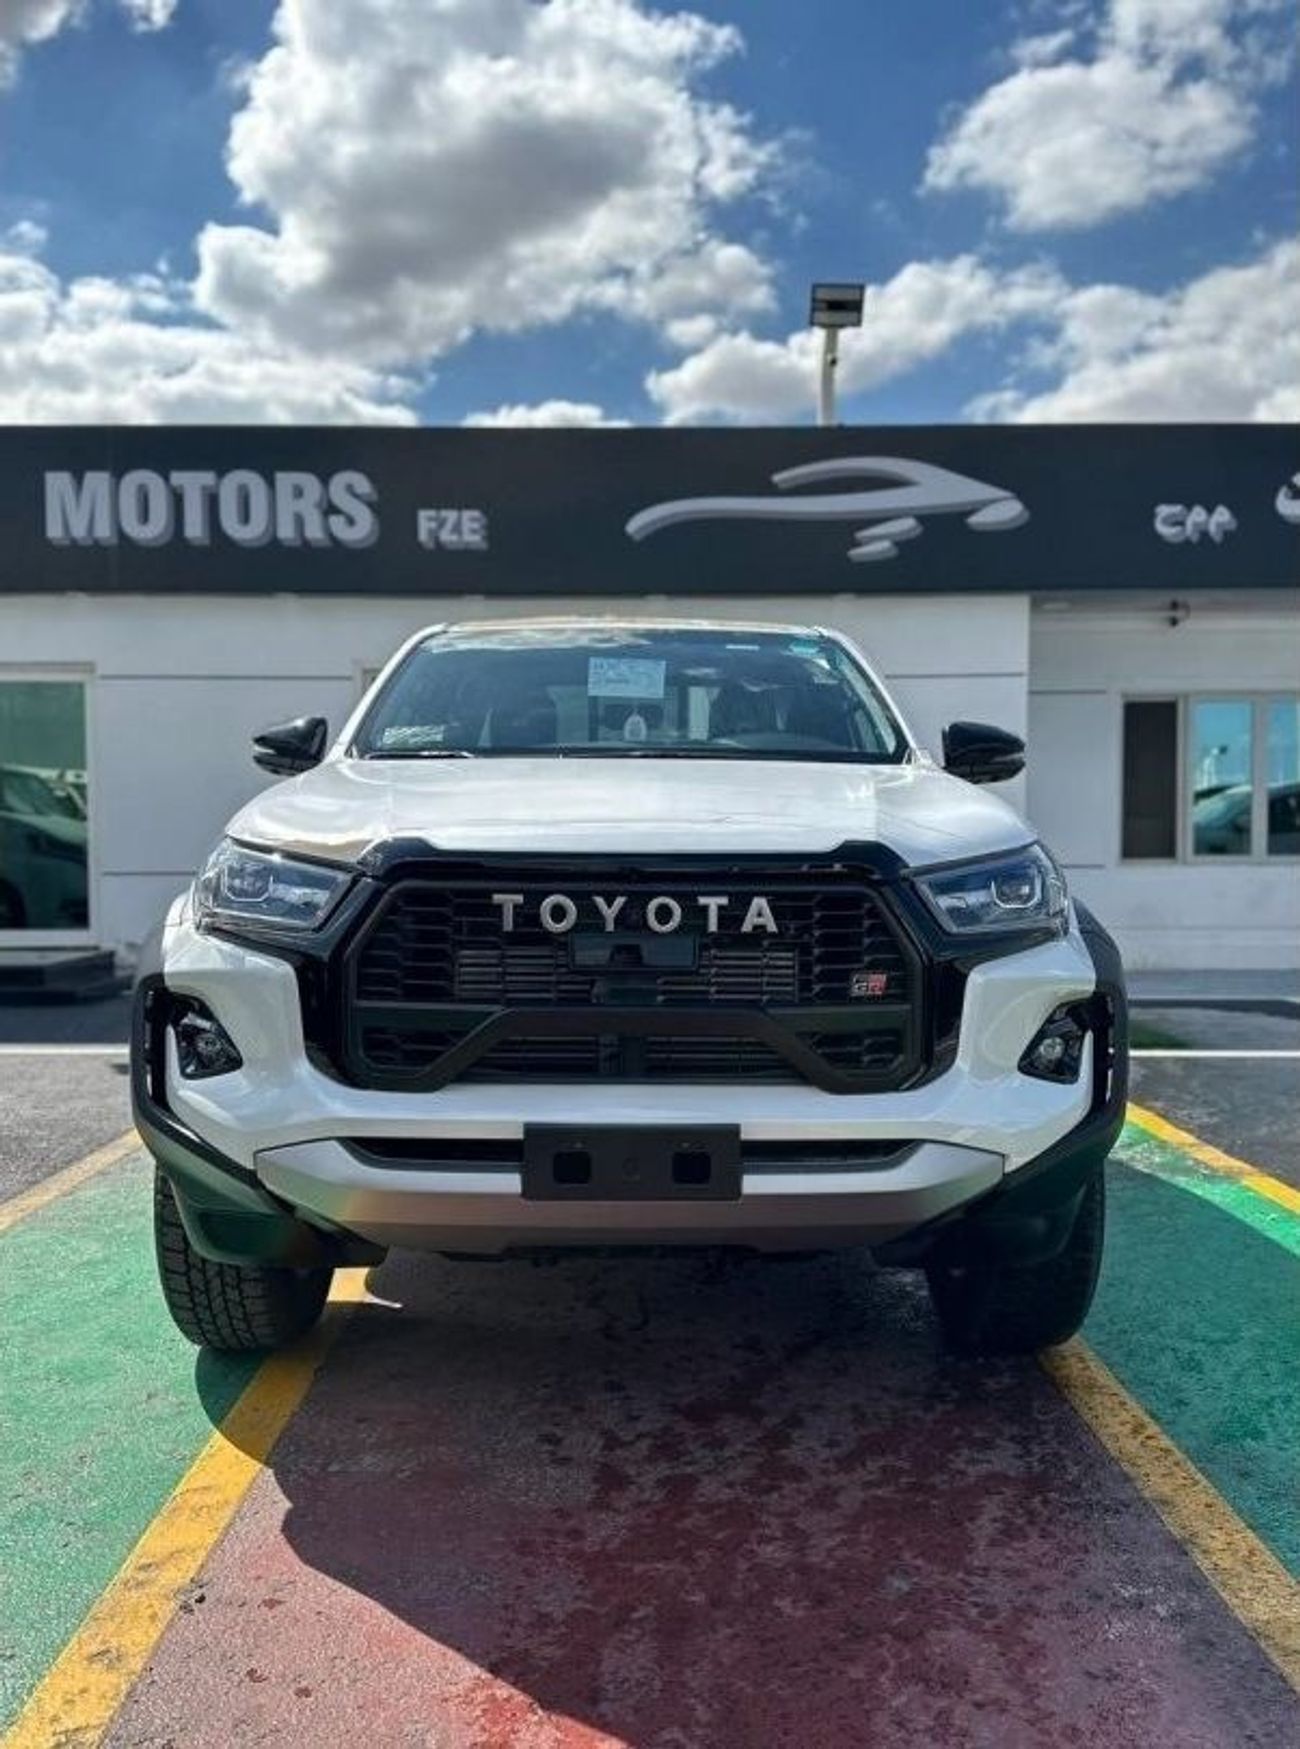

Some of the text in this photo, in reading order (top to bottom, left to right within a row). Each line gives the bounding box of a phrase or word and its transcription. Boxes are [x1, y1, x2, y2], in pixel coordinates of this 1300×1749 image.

[44, 469, 488, 550] MOTORS FZE
[492, 893, 779, 934] TOYOTA
